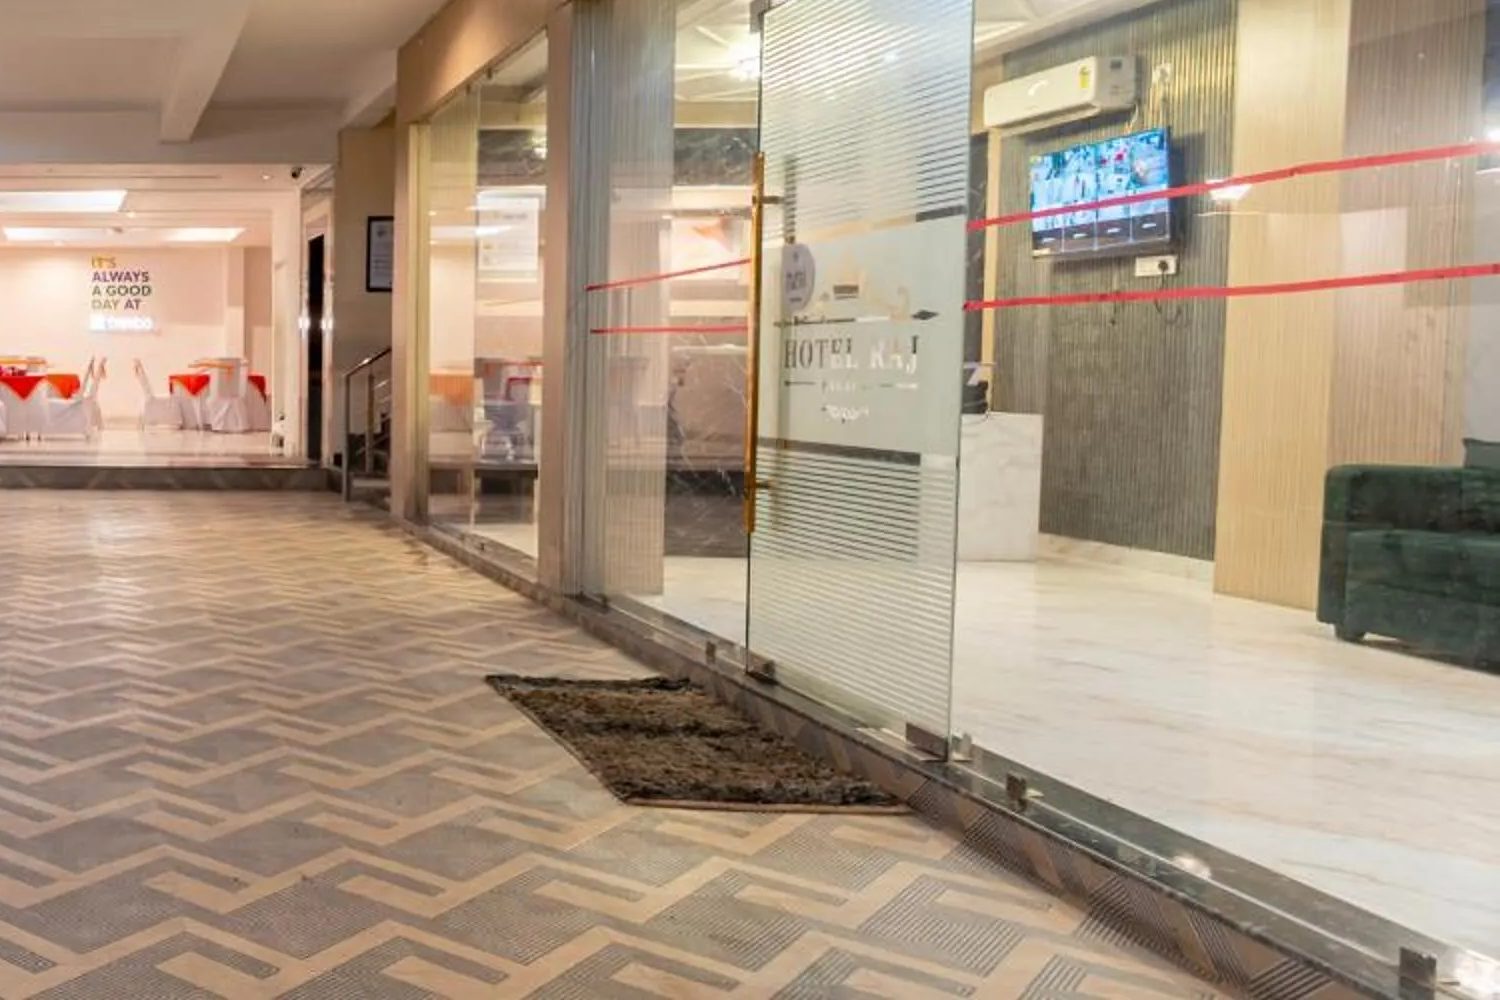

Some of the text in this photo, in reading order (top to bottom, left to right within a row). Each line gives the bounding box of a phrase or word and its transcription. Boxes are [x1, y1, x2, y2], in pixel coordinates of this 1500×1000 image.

[91, 271, 149, 283] ALWAYS
[91, 285, 152, 296] A GOOD
[91, 299, 142, 310] DAY AT
[784, 337, 858, 370] HOTEL
